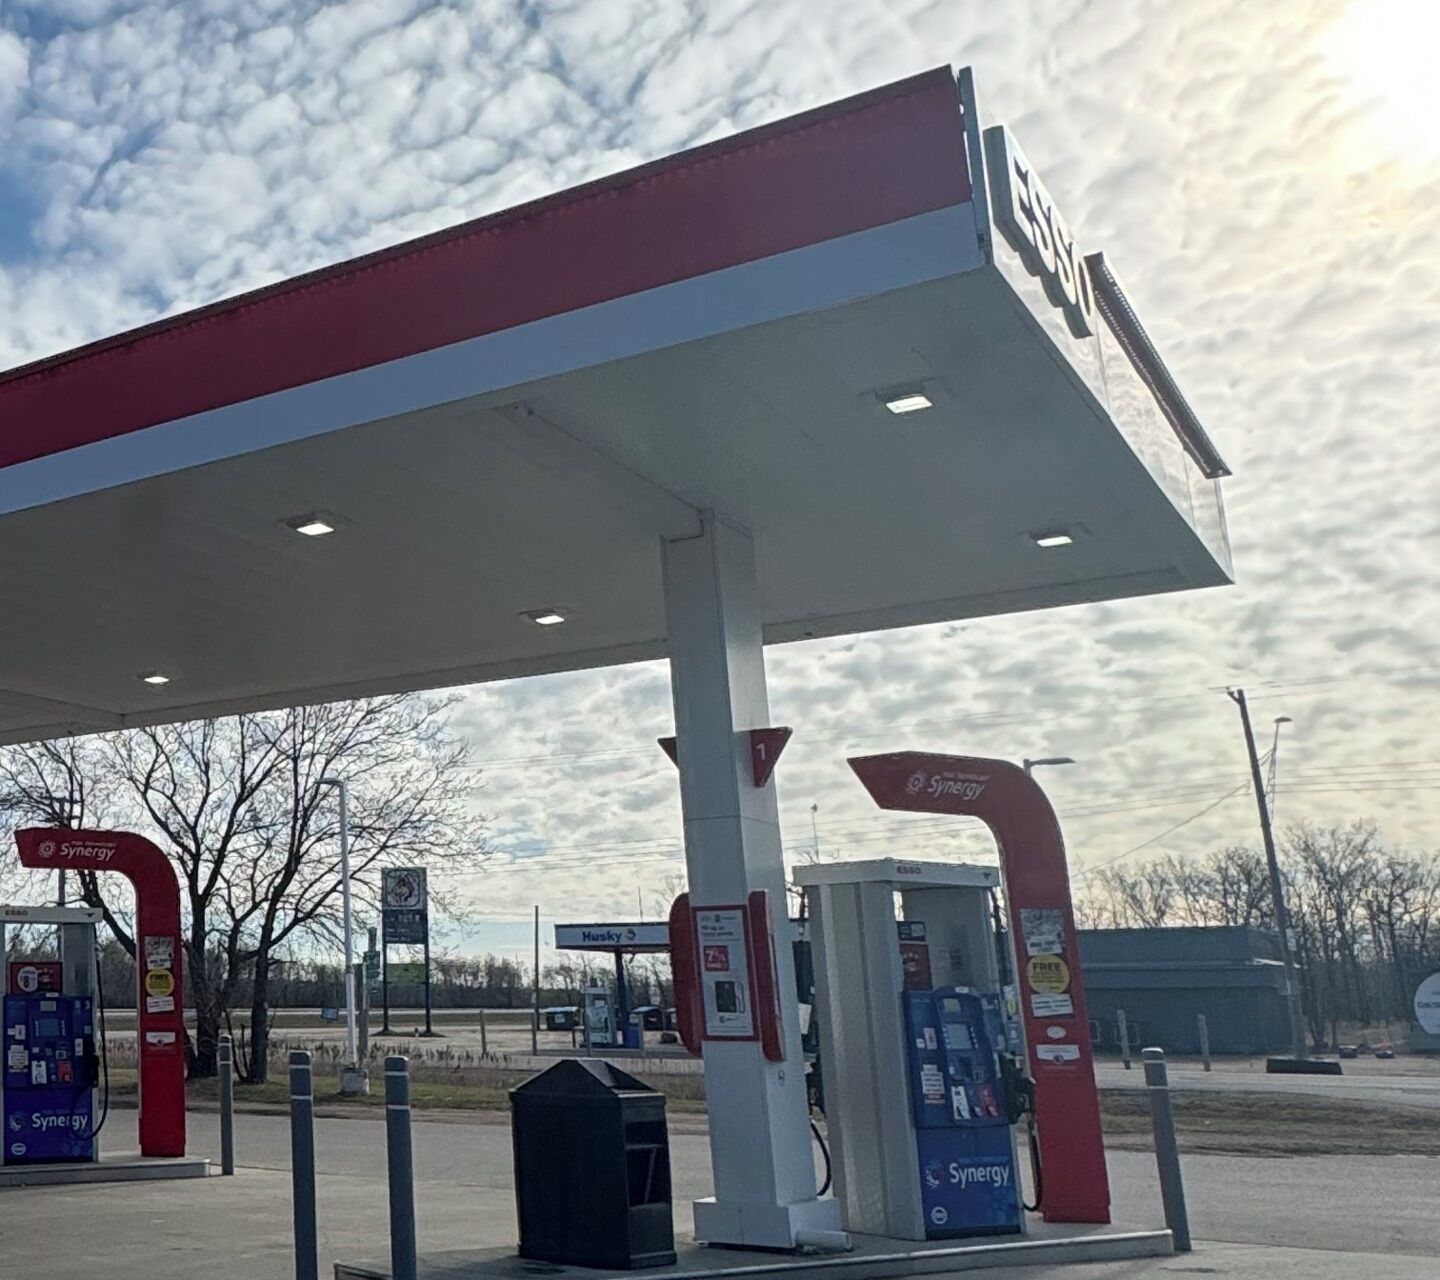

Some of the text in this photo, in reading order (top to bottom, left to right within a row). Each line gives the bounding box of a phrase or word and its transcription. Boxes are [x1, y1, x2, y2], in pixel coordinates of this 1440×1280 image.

[756, 742, 766, 761] 1
[927, 774, 985, 801] Synergy
[60, 843, 115, 861] Synergy
[582, 931, 622, 943] Husky
[1032, 962, 1062, 972] FREE
[32, 1112, 89, 1132] Synergy
[949, 1162, 1010, 1189] Synergy
